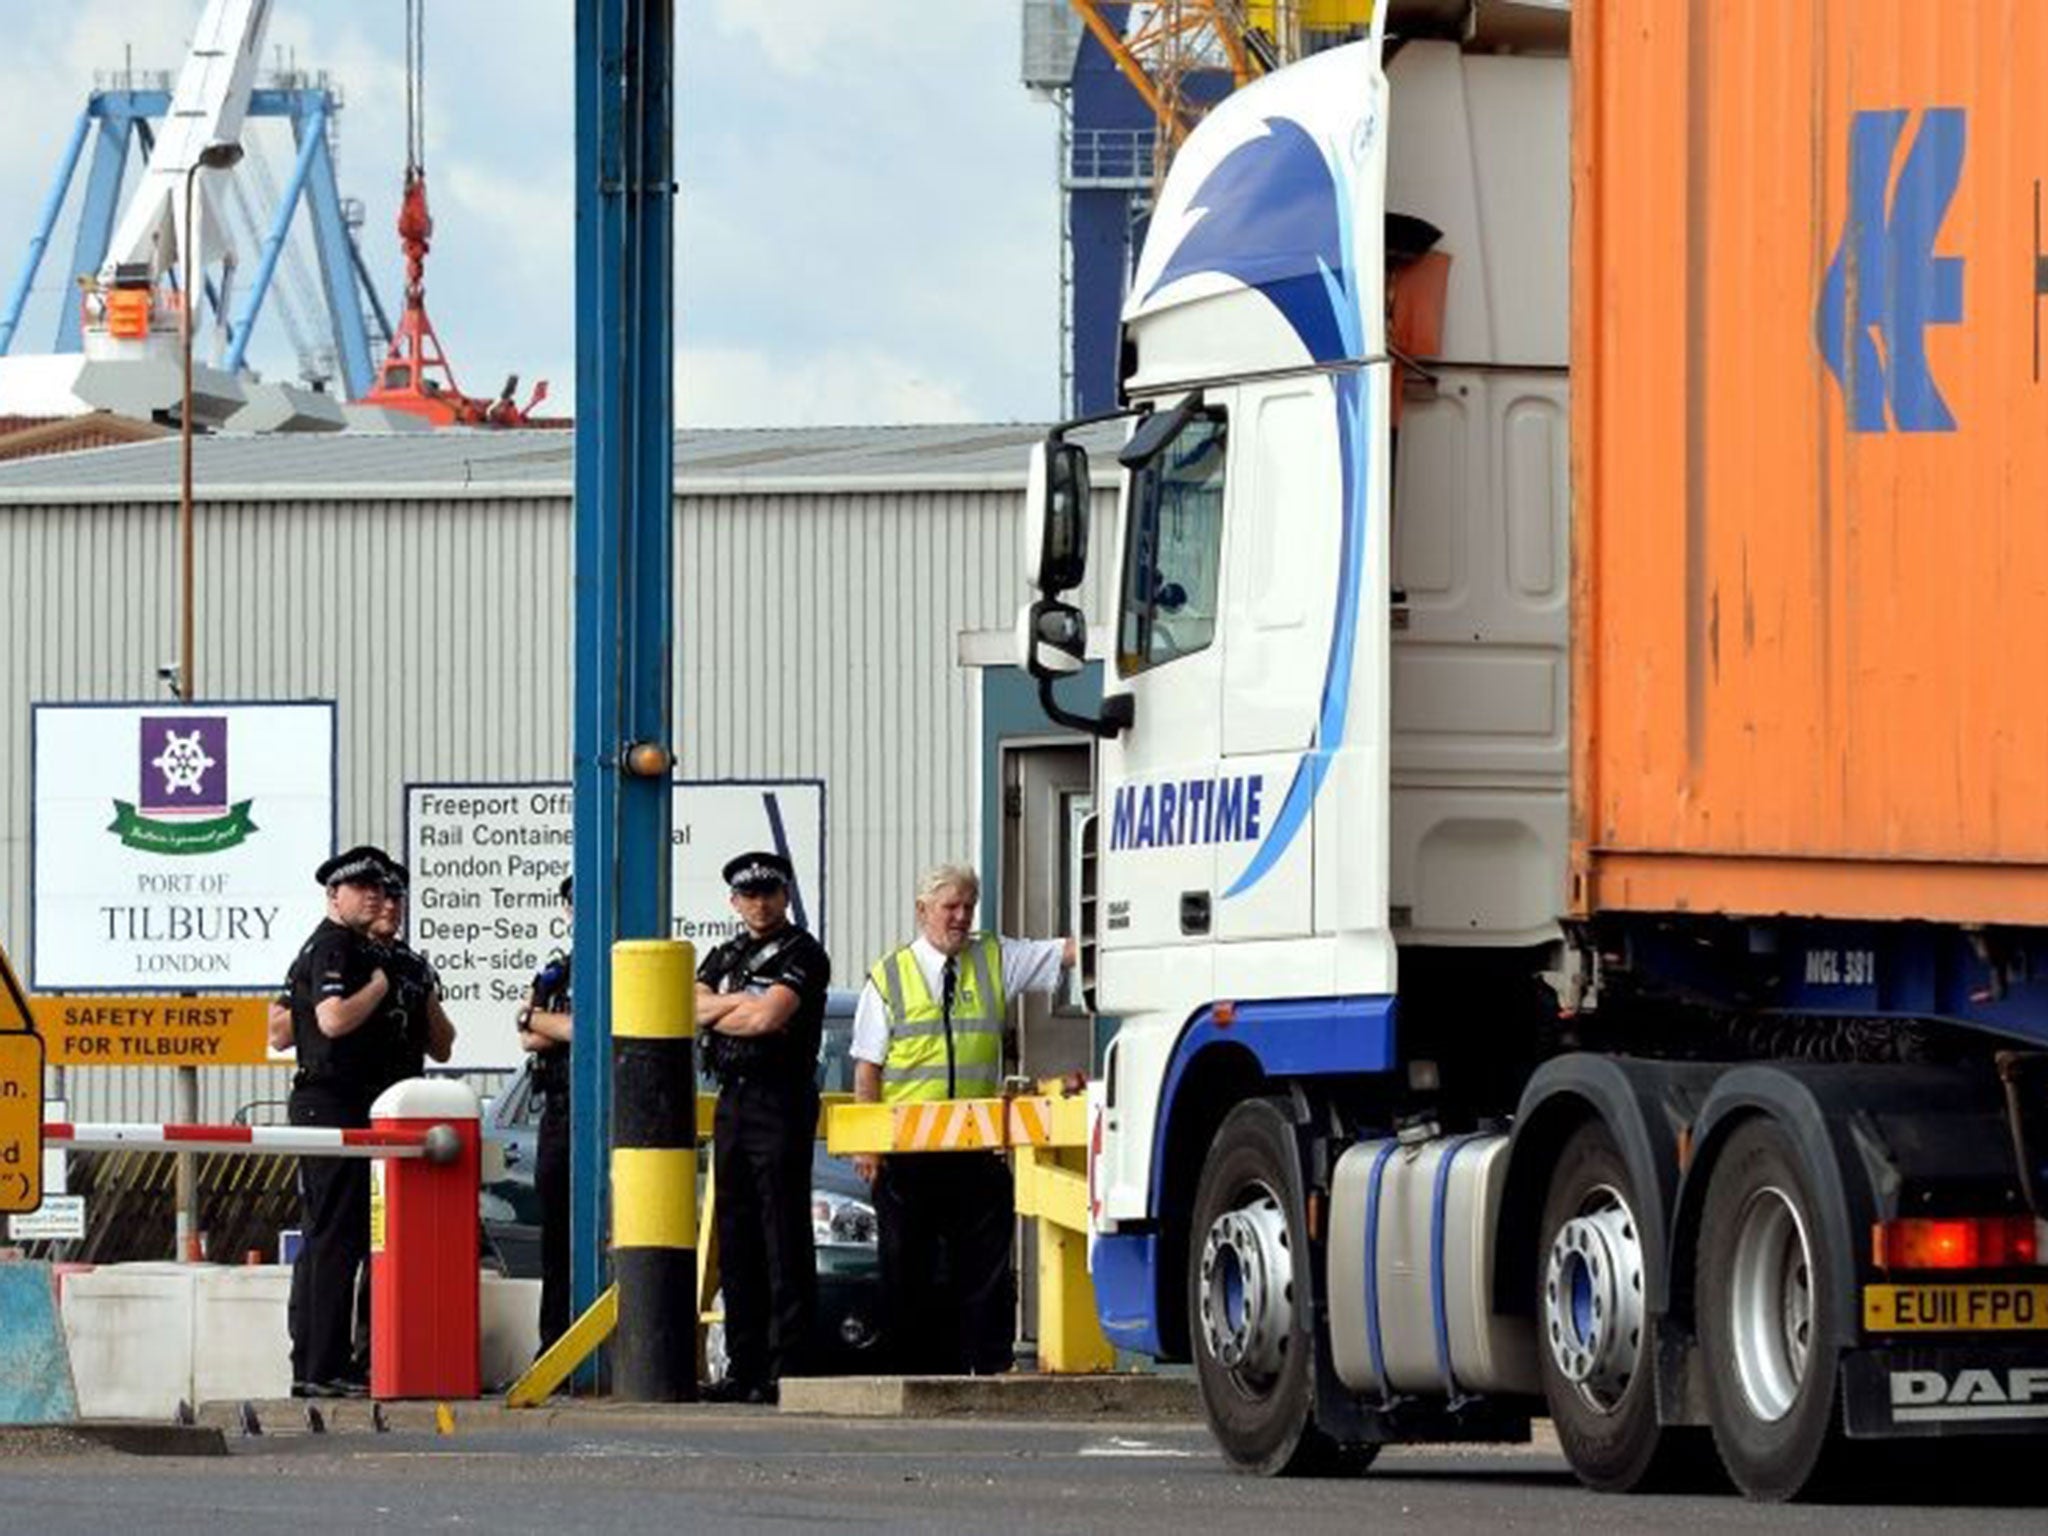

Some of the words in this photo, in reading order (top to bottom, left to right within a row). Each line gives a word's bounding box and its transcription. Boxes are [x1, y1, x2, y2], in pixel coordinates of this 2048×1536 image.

[421, 793, 519, 819] Freeport
[1109, 774, 1263, 852] MARITIME
[420, 825, 463, 846] Rail
[420, 856, 501, 878] London
[508, 854, 570, 881] Paper
[138, 873, 195, 893] PORT
[200, 873, 230, 894] OF
[421, 887, 481, 909] Grain
[100, 906, 279, 941] TILBURY
[420, 917, 538, 943] Deep-Sea
[136, 953, 230, 973] LONDON
[65, 1008, 154, 1026] SAFETY
[164, 1008, 233, 1026] FIRST
[65, 1036, 111, 1055] FOR
[119, 1036, 221, 1055] TILBURY
[1890, 1367, 2048, 1404] DAF
